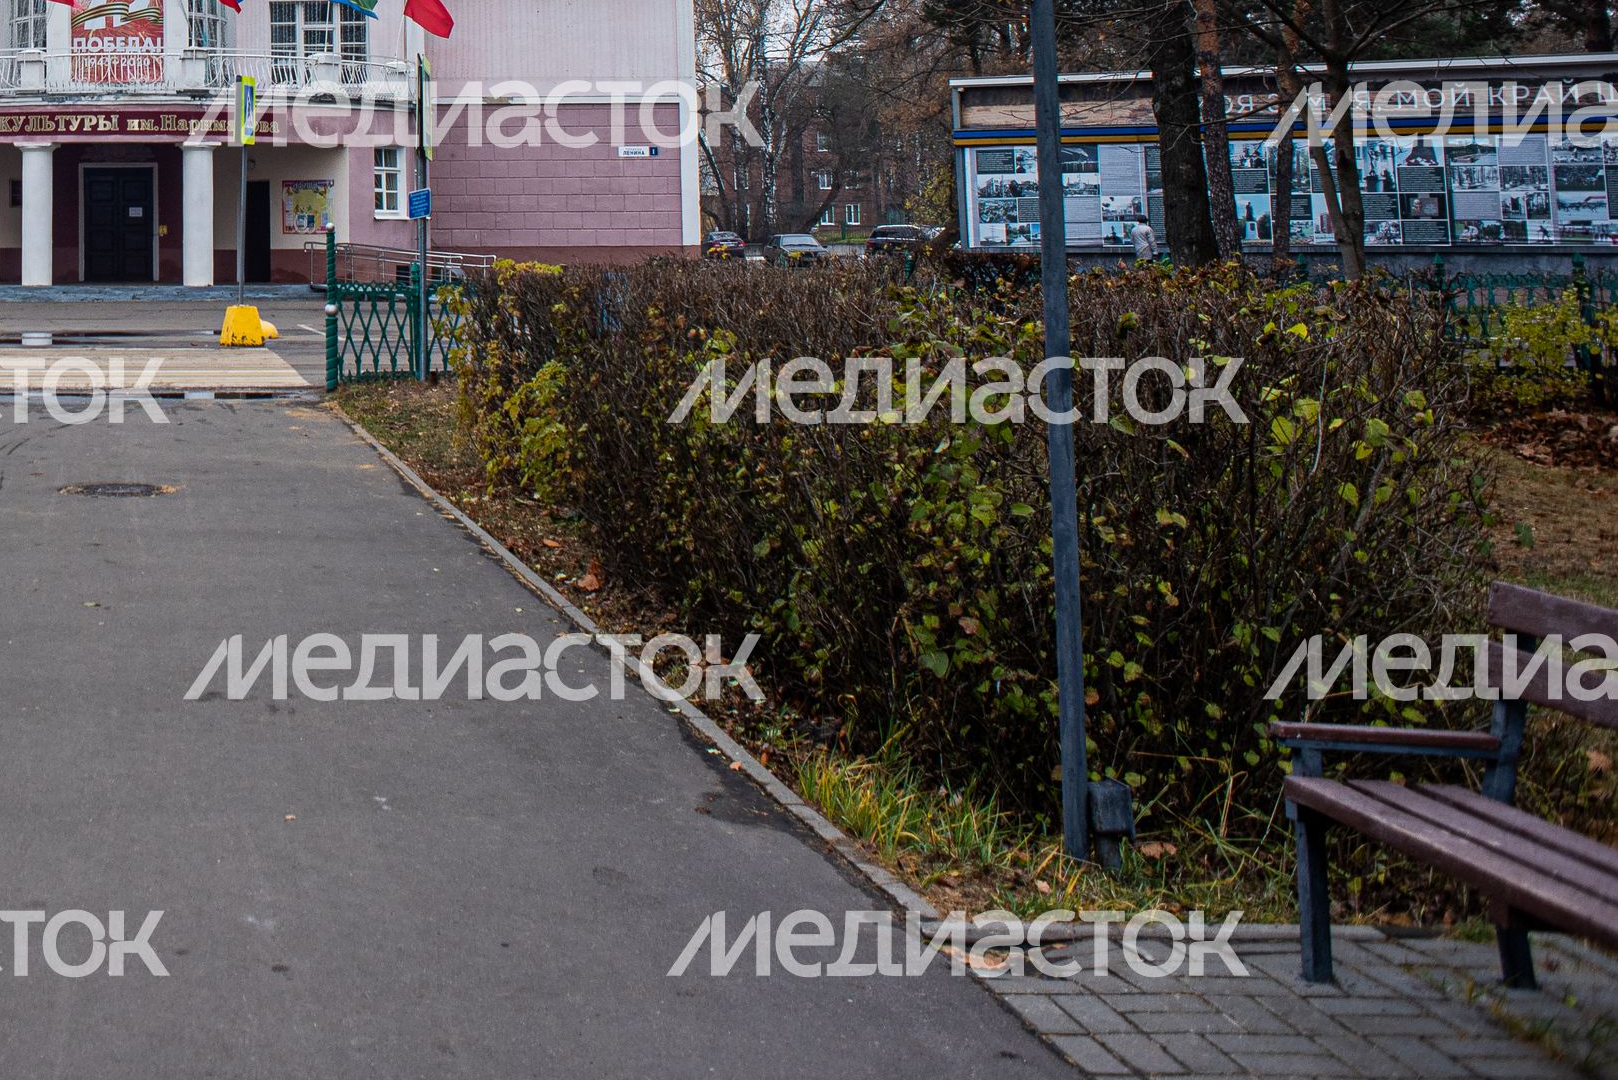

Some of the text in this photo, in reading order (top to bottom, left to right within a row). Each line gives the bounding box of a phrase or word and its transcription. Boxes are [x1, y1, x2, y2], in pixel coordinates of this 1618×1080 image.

[73, 36, 162, 53] ПОБЕДА!
[1397, 82, 1470, 110] МОЙ
[1488, 78, 1580, 107] КРАЙ
